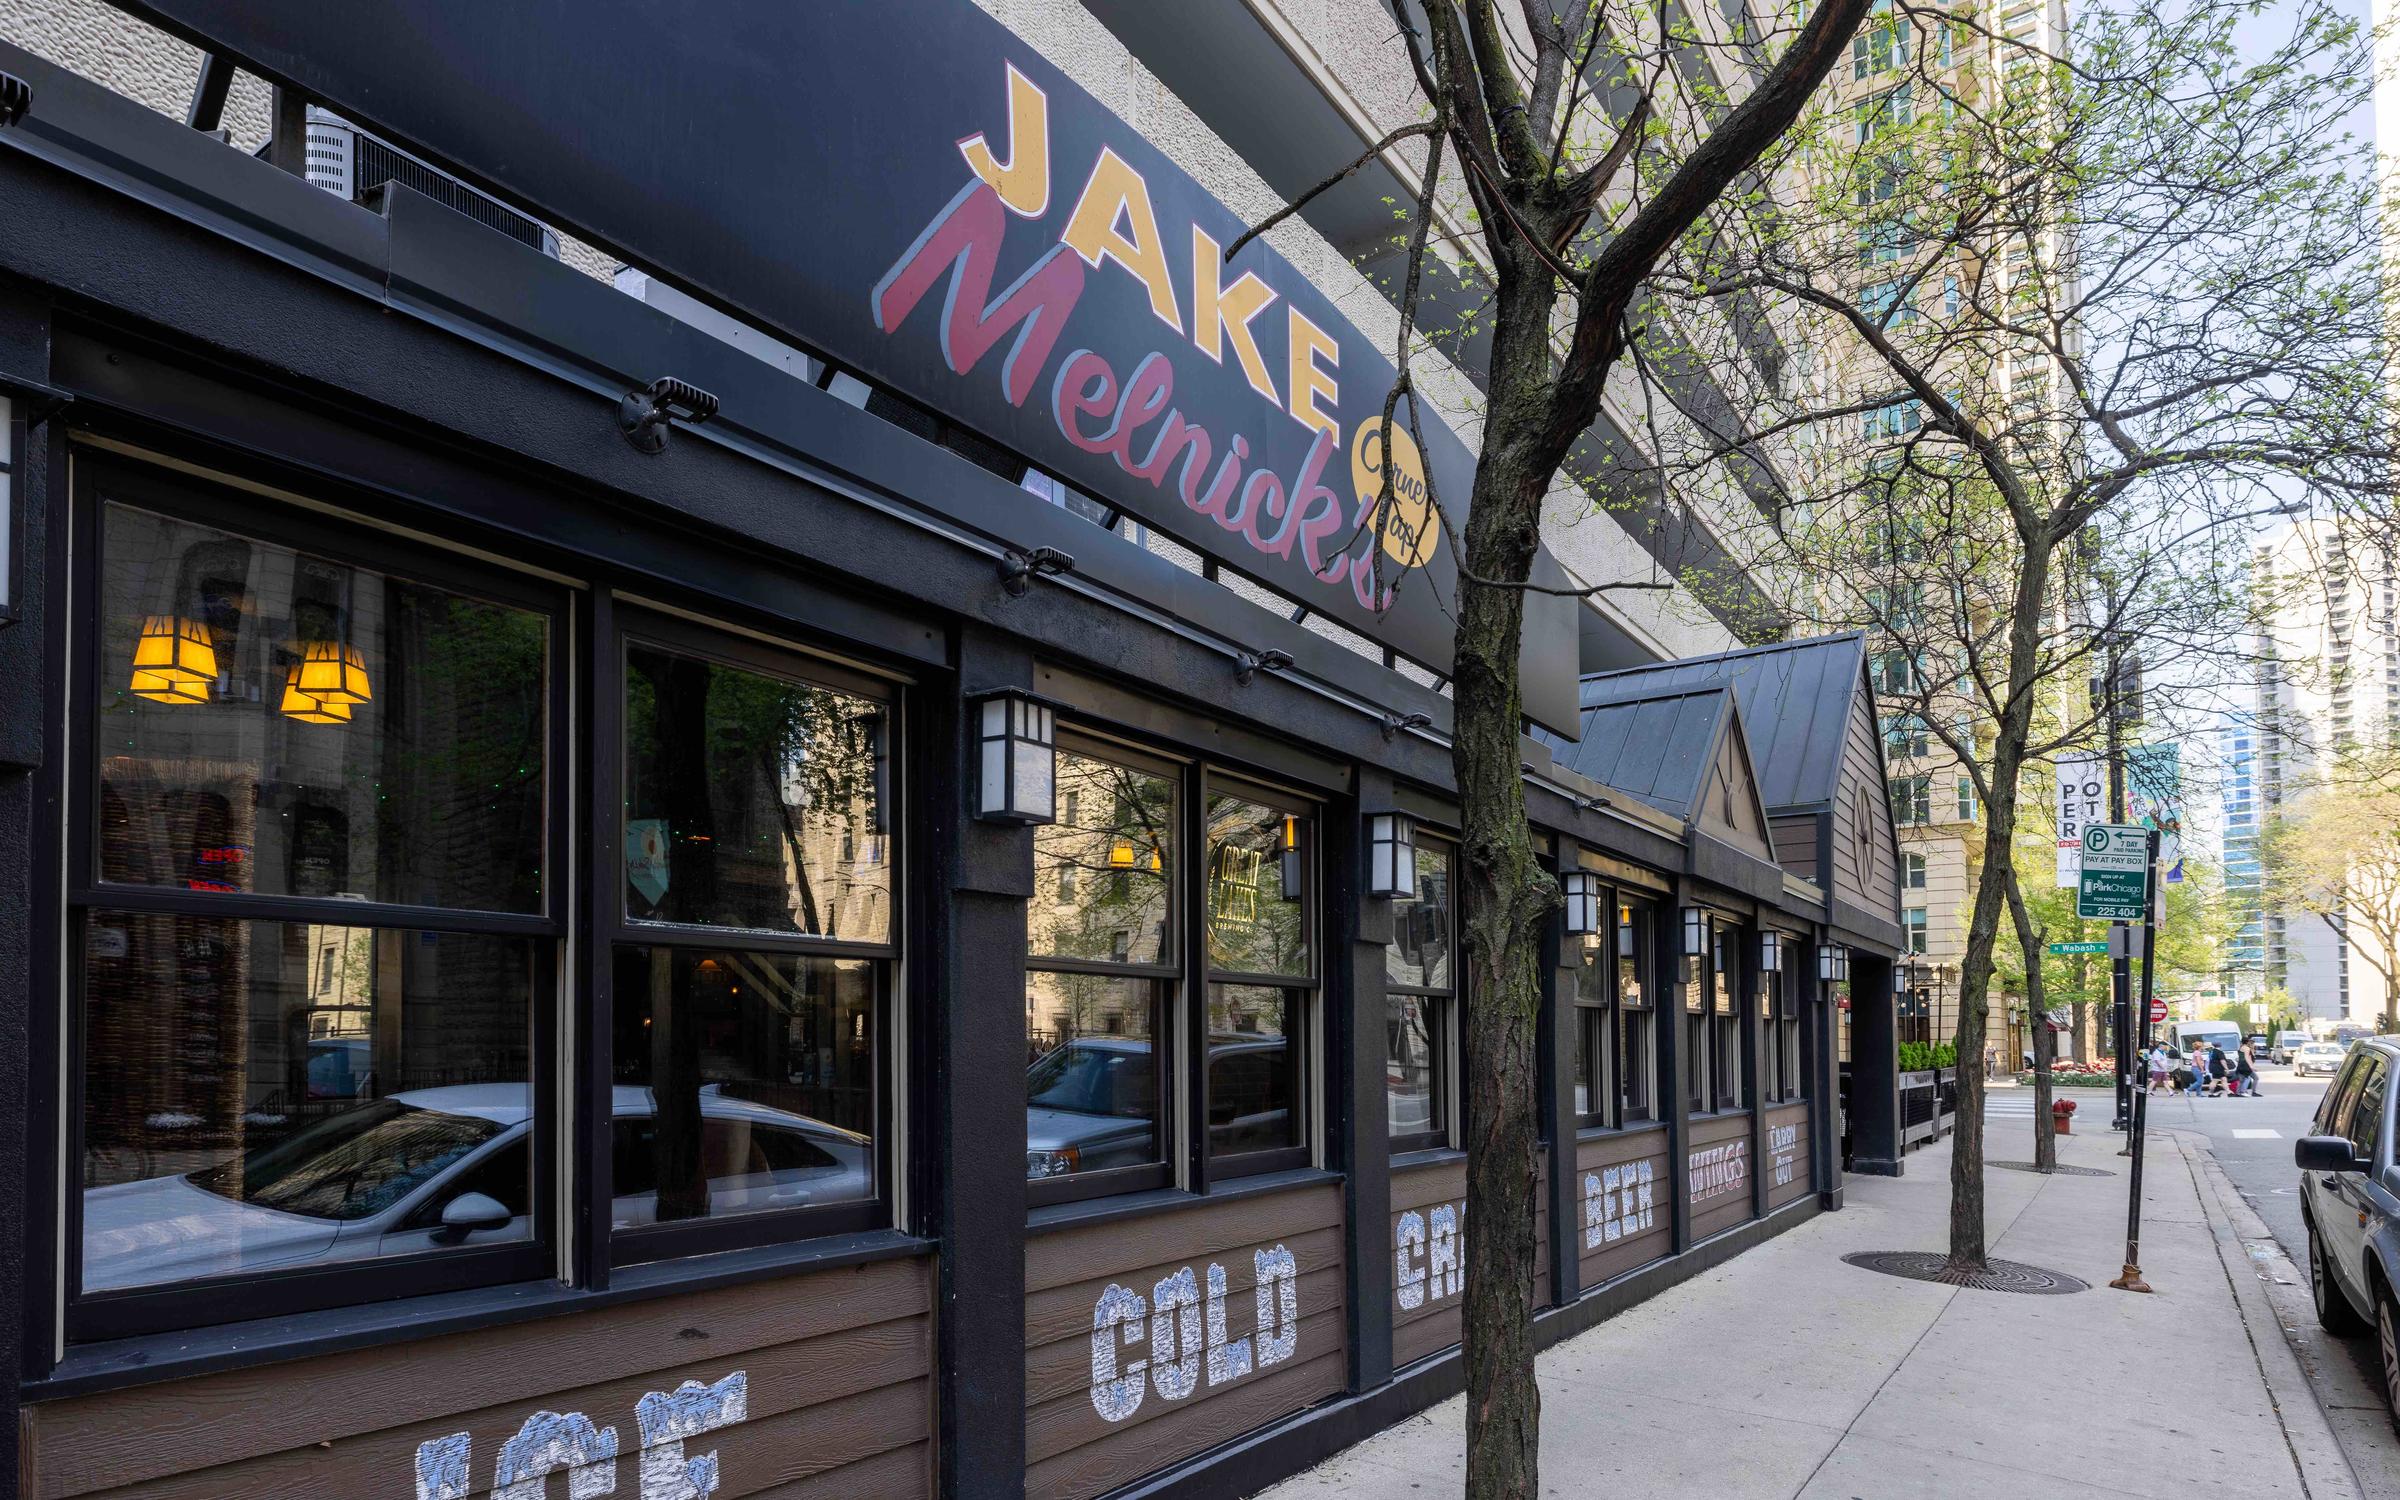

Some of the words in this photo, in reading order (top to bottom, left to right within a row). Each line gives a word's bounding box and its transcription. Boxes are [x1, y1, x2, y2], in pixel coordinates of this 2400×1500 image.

[956, 58, 1340, 449] JAKE
[871, 177, 1392, 611] Melnick's
[1361, 429, 1434, 513] Crne
[1222, 845, 1263, 887] GREAT
[1216, 884, 1258, 923] LAKES
[2093, 883, 2142, 894] ParkChicago
[1215, 922, 1244, 933] BREWING
[2097, 907, 2116, 916] 225
[2118, 908, 2136, 917] 404
[2062, 944, 2096, 952] Wabash
[1769, 1123, 1796, 1155] CARRY
[1689, 1141, 1745, 1204] WINGS
[1775, 1155, 1793, 1186] OUT
[1584, 1159, 1654, 1250] BEER
[1090, 1243, 1298, 1423] COLD
